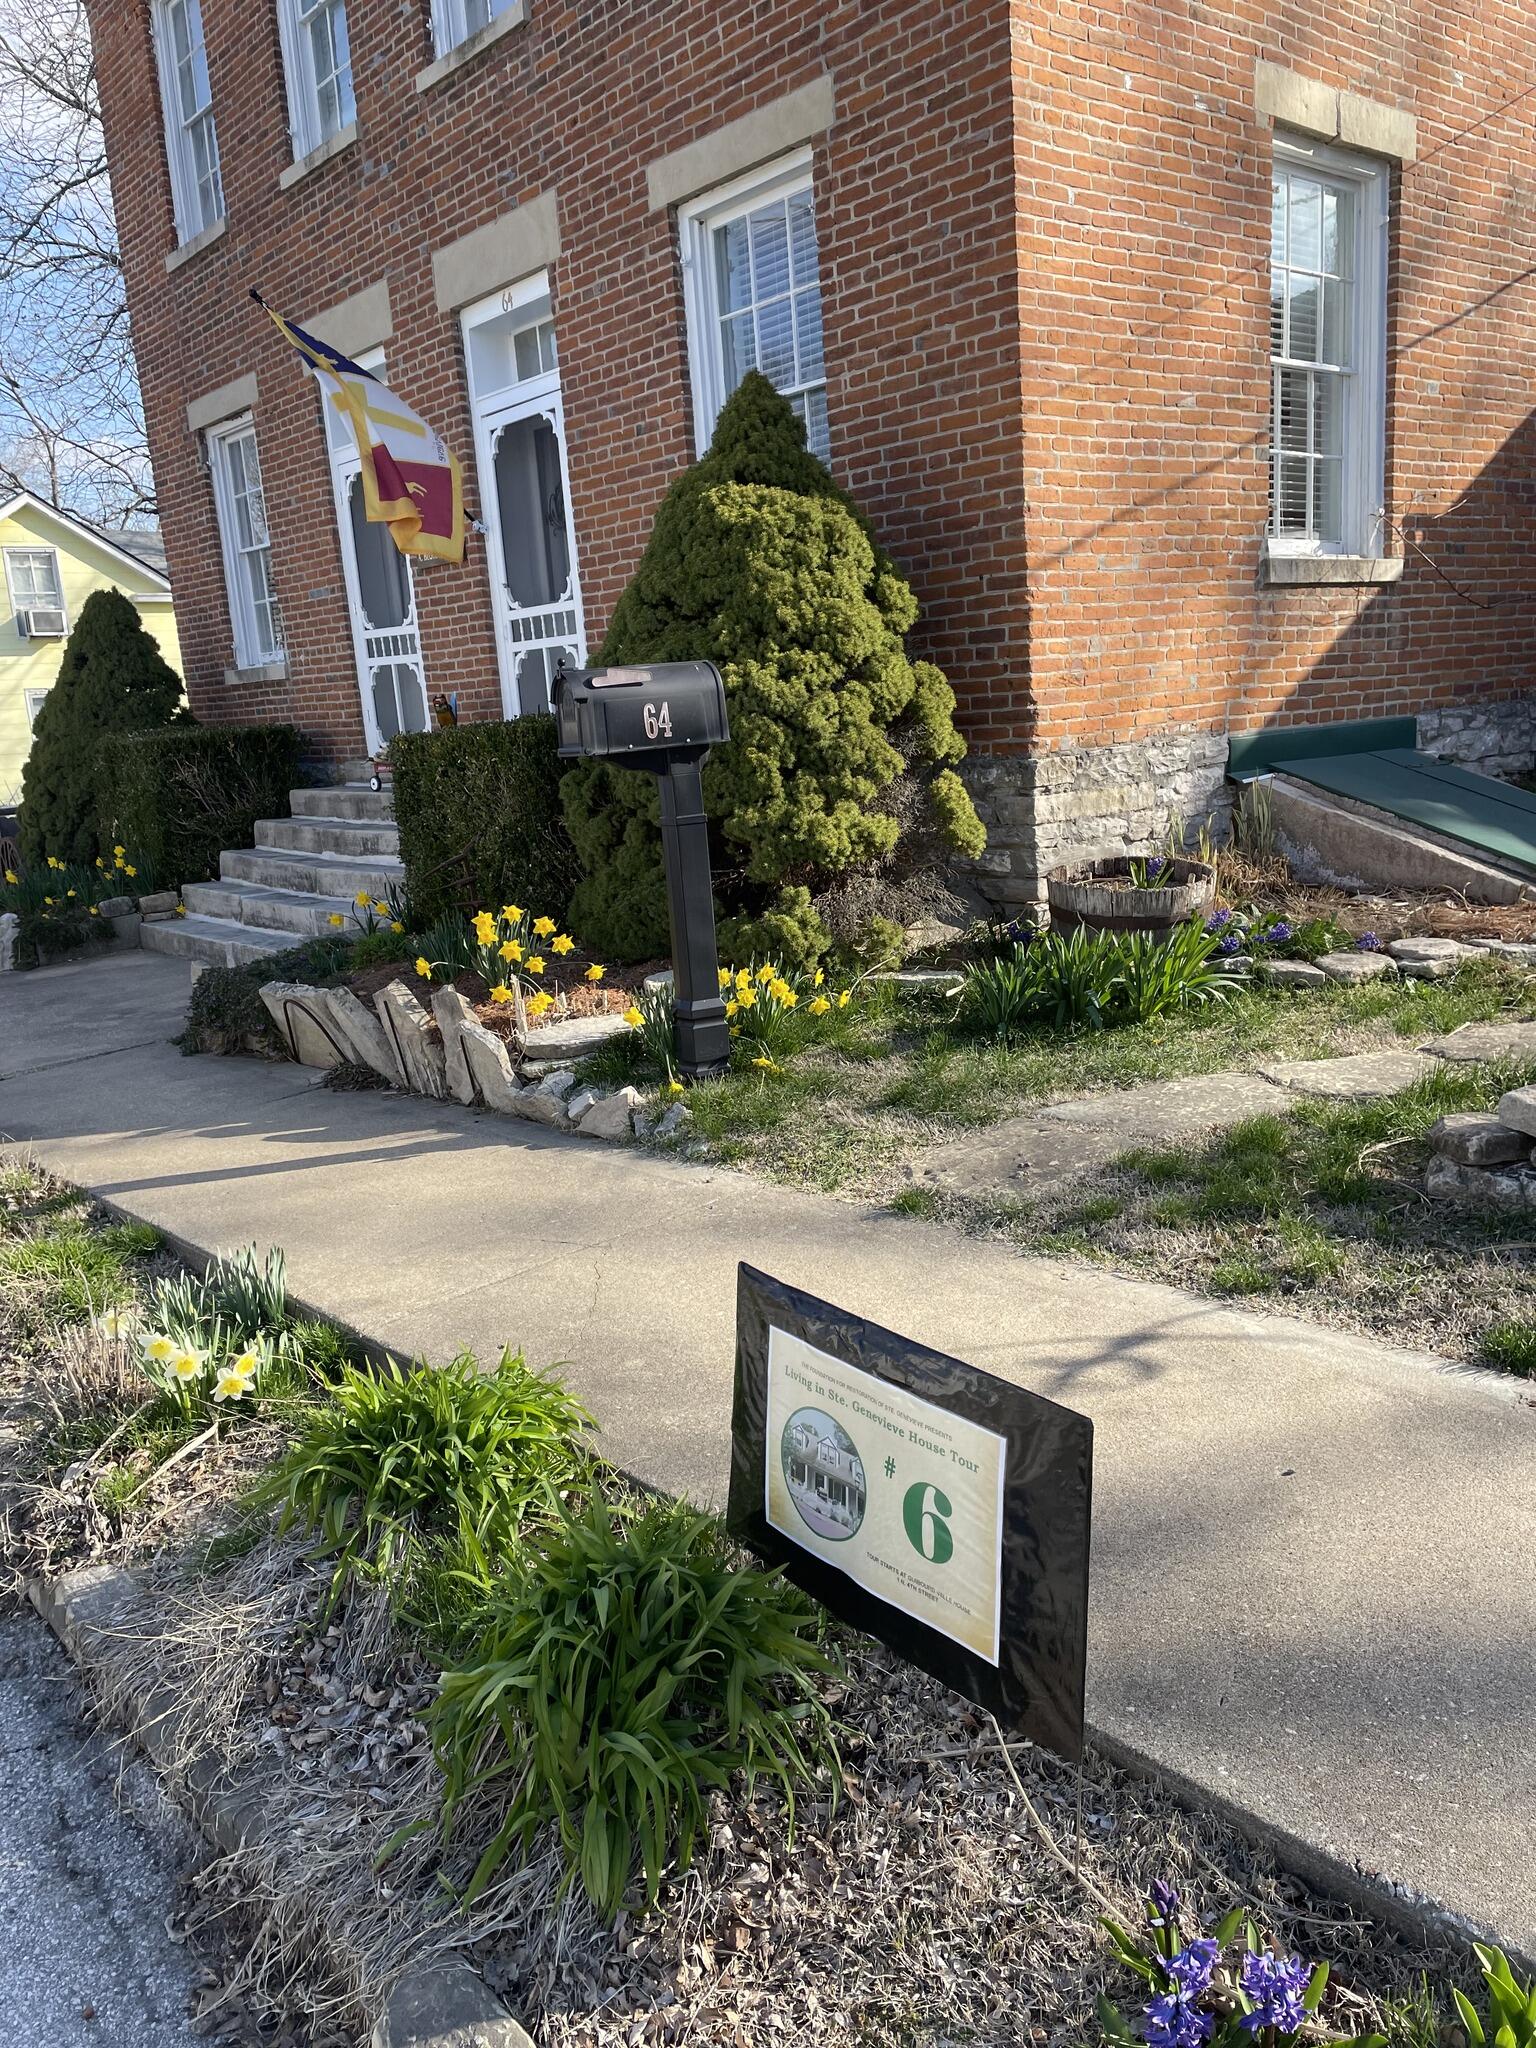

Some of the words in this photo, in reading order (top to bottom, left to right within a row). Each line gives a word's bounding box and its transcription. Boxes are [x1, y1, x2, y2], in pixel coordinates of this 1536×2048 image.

[502, 292, 513, 312] 64
[643, 701, 673, 739] 64
[785, 1365, 813, 1392] Living
[815, 1382, 825, 1396] in
[828, 1388, 848, 1408] Ste.
[852, 1400, 905, 1438] Genevieve
[908, 1430, 946, 1456] House
[950, 1449, 980, 1474] Tour
[877, 1400, 885, 1408] OF
[896, 1410, 924, 1429] GENEVIEVE
[924, 1424, 953, 1442] PRESENTS
[884, 1455, 896, 1479] #
[902, 1481, 954, 1564] 6
[866, 1551, 880, 1564] TOUR
[880, 1560, 900, 1575] STARTS
[900, 1570, 907, 1579] AT
[953, 1601, 972, 1616] HOUSE
[907, 1583, 918, 1592] 4TH
[918, 1588, 939, 1603] STREET
